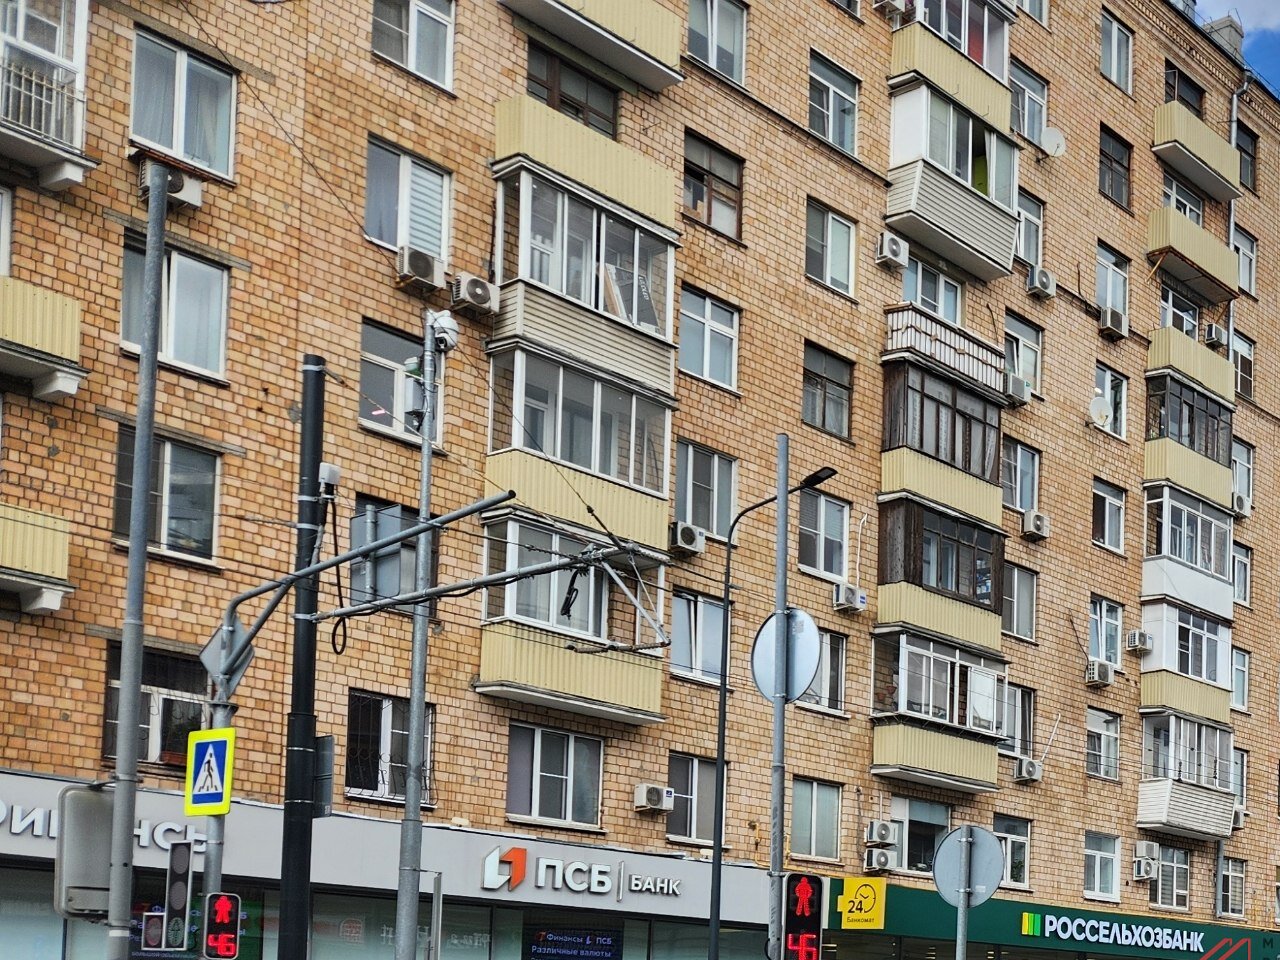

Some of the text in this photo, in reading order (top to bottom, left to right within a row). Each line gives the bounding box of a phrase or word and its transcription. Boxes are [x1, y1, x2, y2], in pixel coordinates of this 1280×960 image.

[535, 857, 681, 896] ПСБ БАНК
[847, 900, 864, 914] 24
[208, 933, 237, 957] 46
[1044, 914, 1205, 953] РОССЕЛЬХОЗБАНК
[531, 945, 579, 956] Различные
